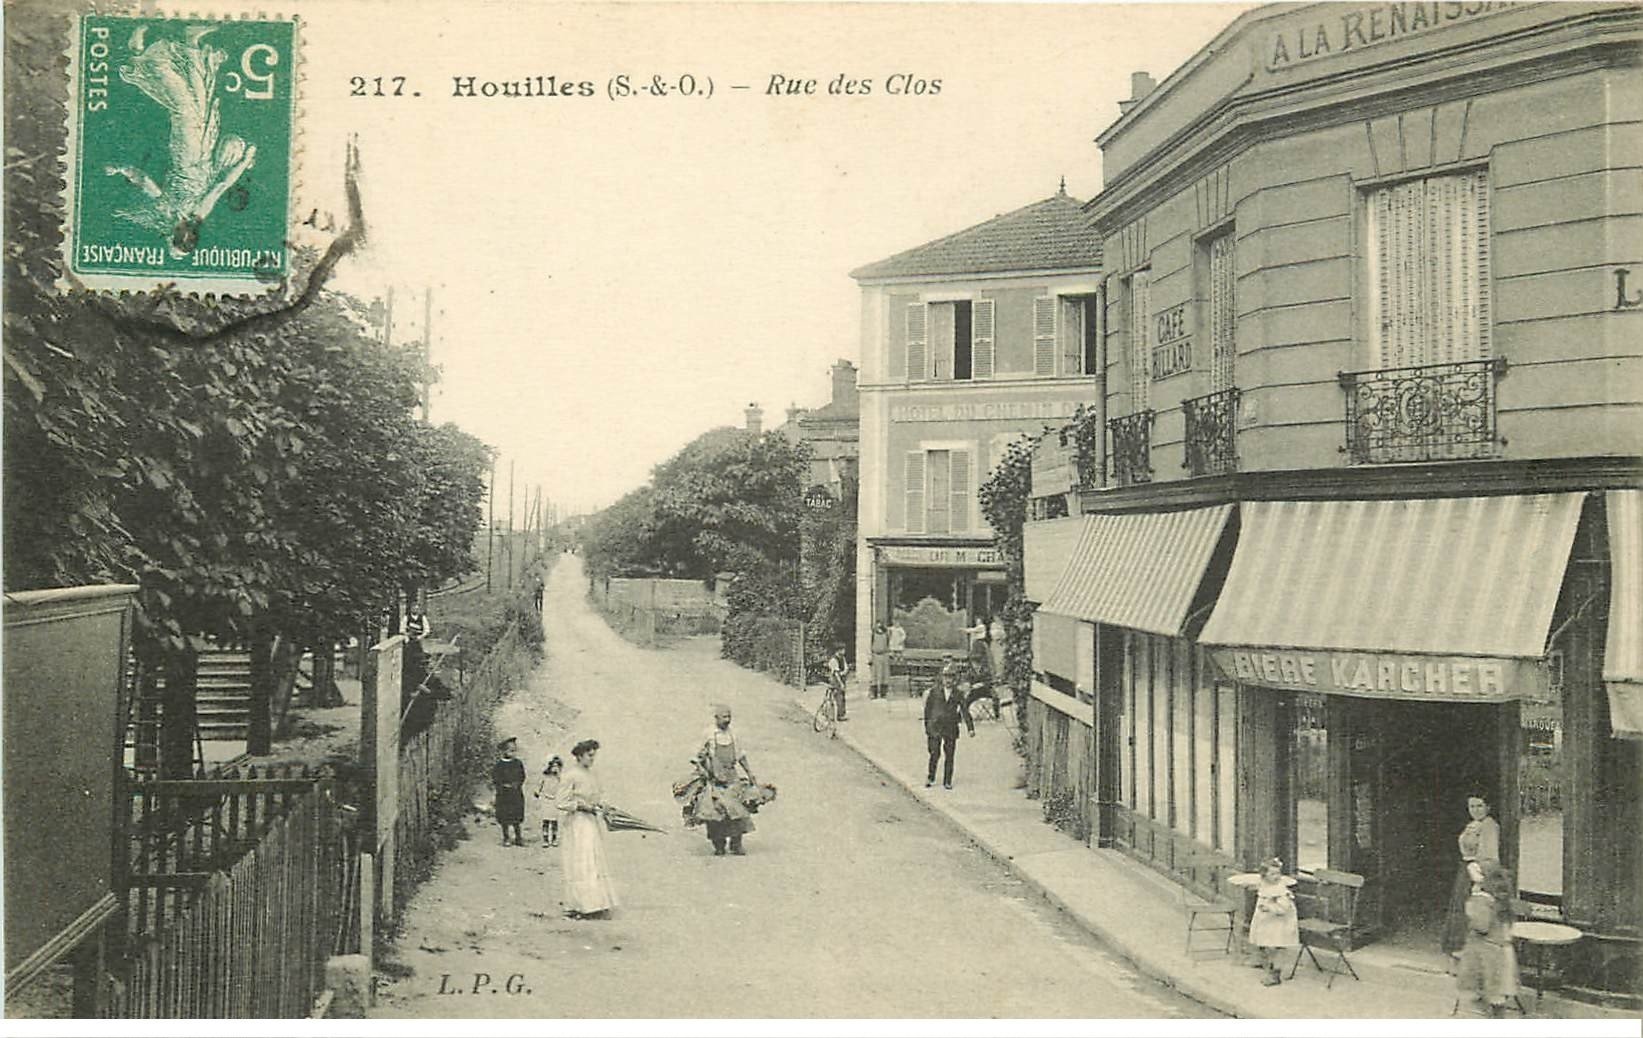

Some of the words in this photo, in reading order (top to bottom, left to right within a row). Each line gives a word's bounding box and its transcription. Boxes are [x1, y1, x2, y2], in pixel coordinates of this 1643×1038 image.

[1273, 34, 1290, 66] A
[1299, 24, 1331, 59] LA
[88, 27, 109, 113] POSTES
[82, 245, 165, 266] FRANÇAISE
[1151, 342, 1192, 380] BILLARD
[805, 497, 832, 509] TABAC
[1331, 656, 1504, 696] KARCHER
